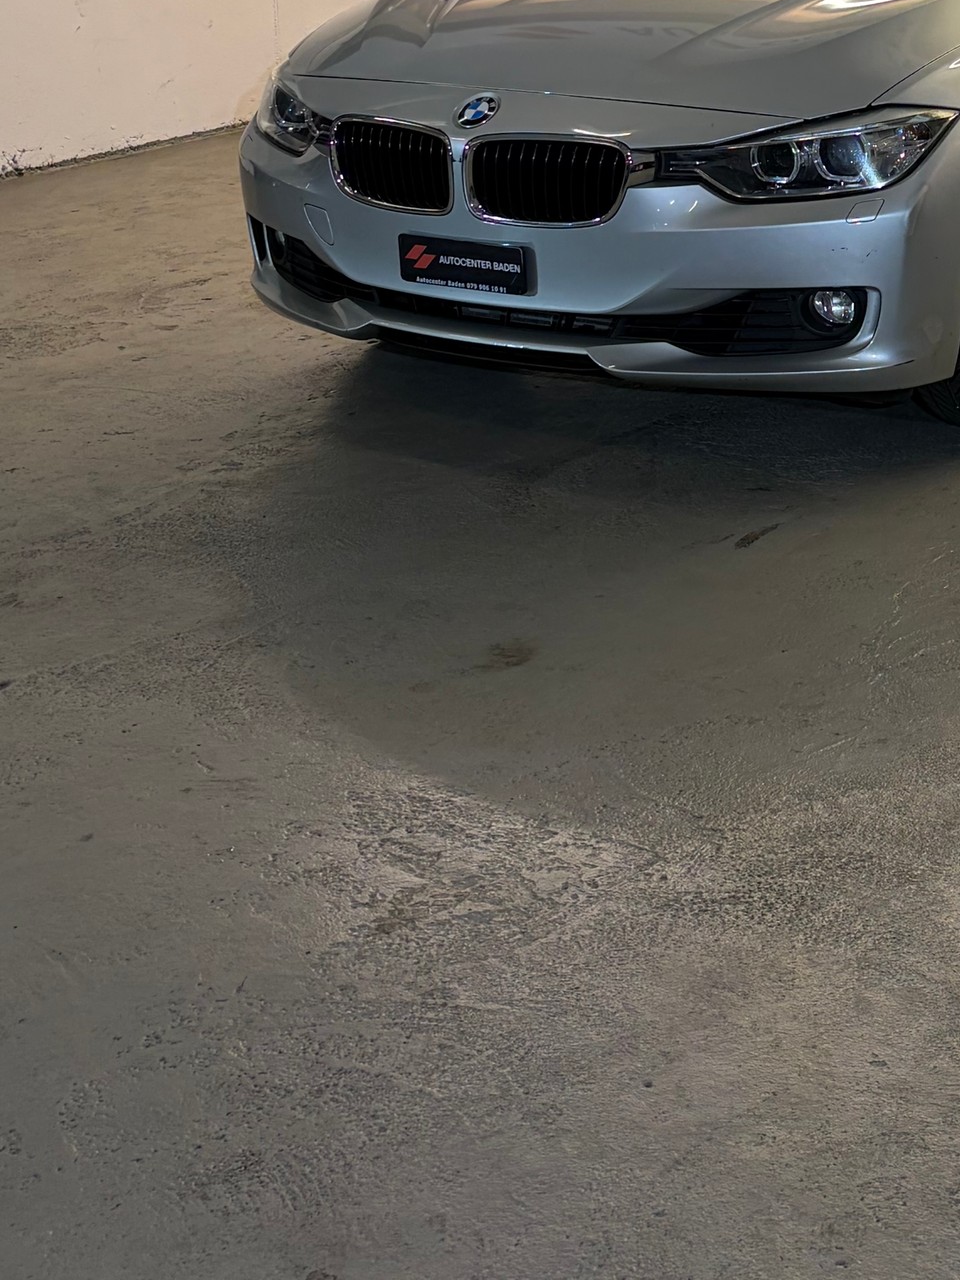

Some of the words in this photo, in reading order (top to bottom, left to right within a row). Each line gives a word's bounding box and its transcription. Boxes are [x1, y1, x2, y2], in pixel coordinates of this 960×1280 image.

[439, 255, 492, 270] AUTOCENTER
[493, 262, 521, 274] BADEN
[416, 276, 447, 286] Autocenter
[447, 280, 465, 288] Baden
